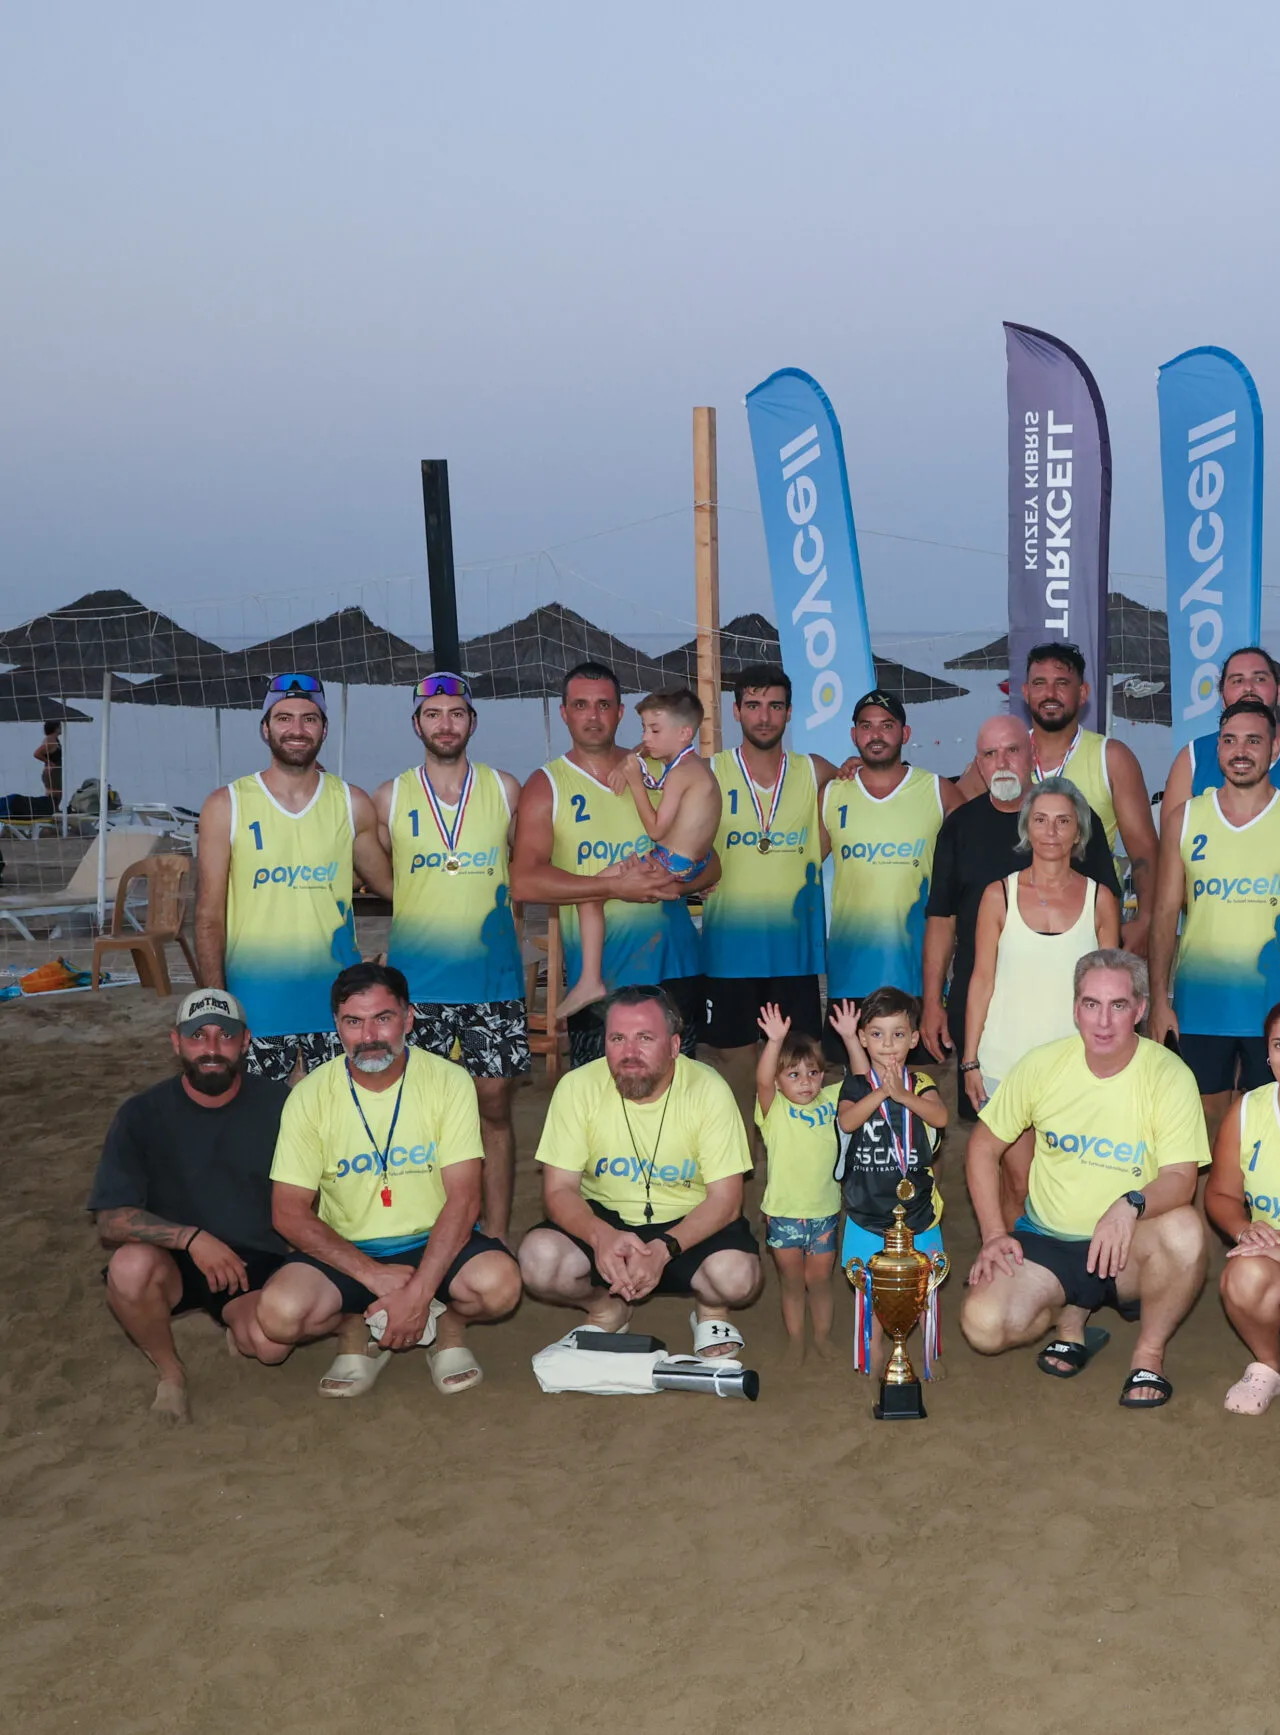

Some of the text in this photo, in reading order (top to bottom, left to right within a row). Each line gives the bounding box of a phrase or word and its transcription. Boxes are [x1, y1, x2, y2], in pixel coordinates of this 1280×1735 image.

[570, 793, 591, 824] 2
[727, 788, 739, 815] 1
[408, 808, 420, 838] 1
[838, 804, 849, 829] 1
[248, 820, 264, 851] 1
[1191, 833, 1208, 862] 2
[577, 834, 655, 867] payce
[840, 838, 927, 863] paycell
[252, 861, 340, 890] paycell
[1248, 1139, 1262, 1172] 1
